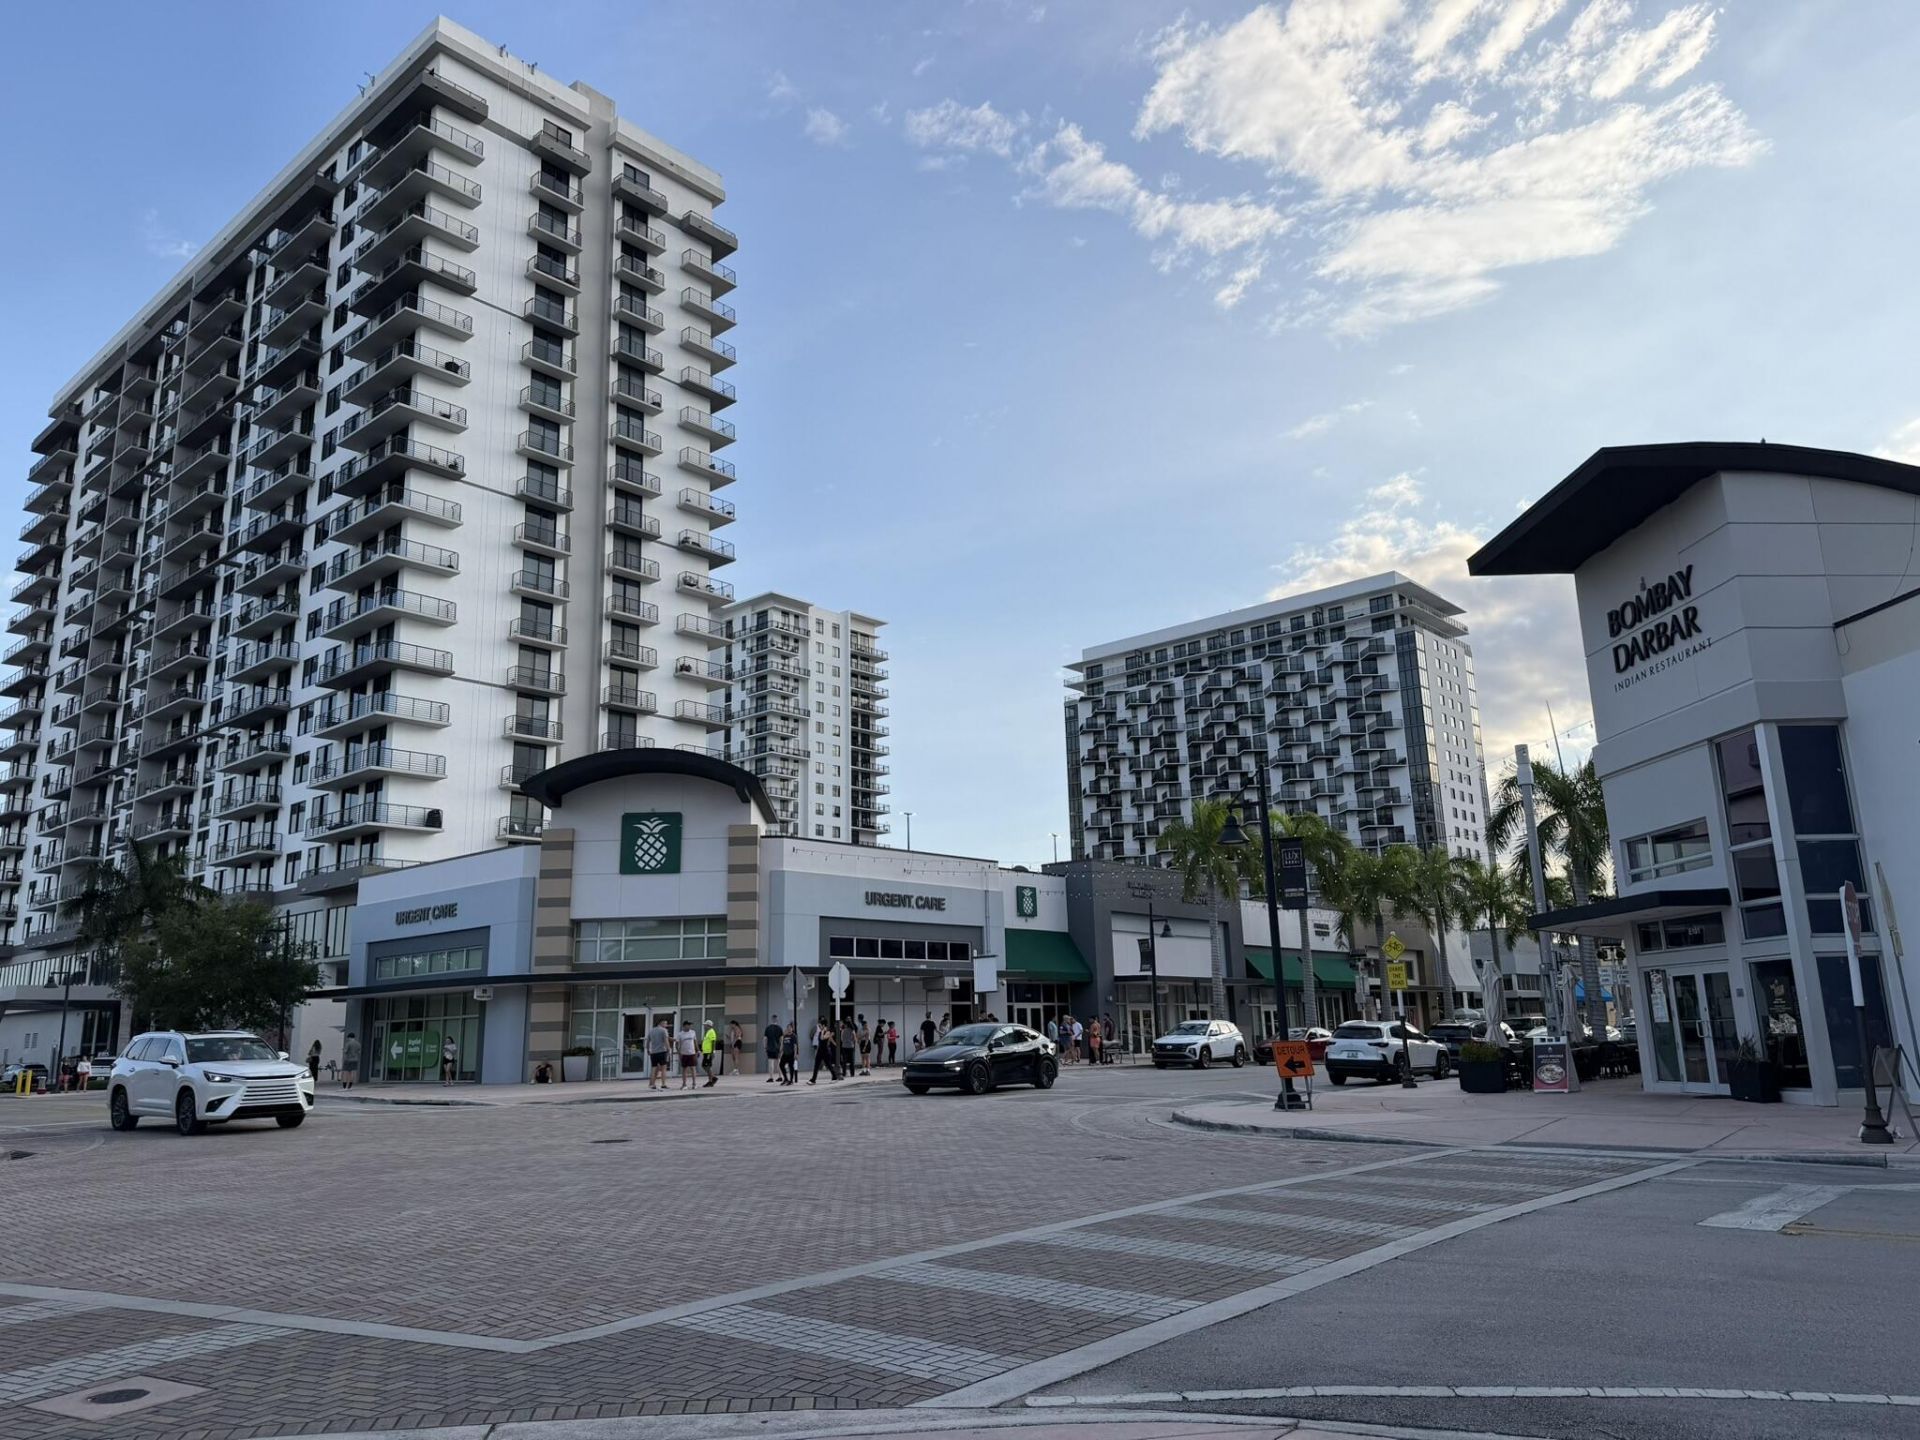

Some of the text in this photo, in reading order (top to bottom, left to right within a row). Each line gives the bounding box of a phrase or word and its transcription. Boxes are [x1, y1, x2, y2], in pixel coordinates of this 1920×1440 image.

[1606, 564, 1693, 638] BOMBAY
[1612, 606, 1703, 674] DARBAR
[1614, 637, 1713, 693] INDIAN RESTAURANT
[395, 902, 458, 926] URGENT CARE
[865, 891, 946, 912] URGENT CARE
[1276, 1044, 1307, 1056] DETOUR
